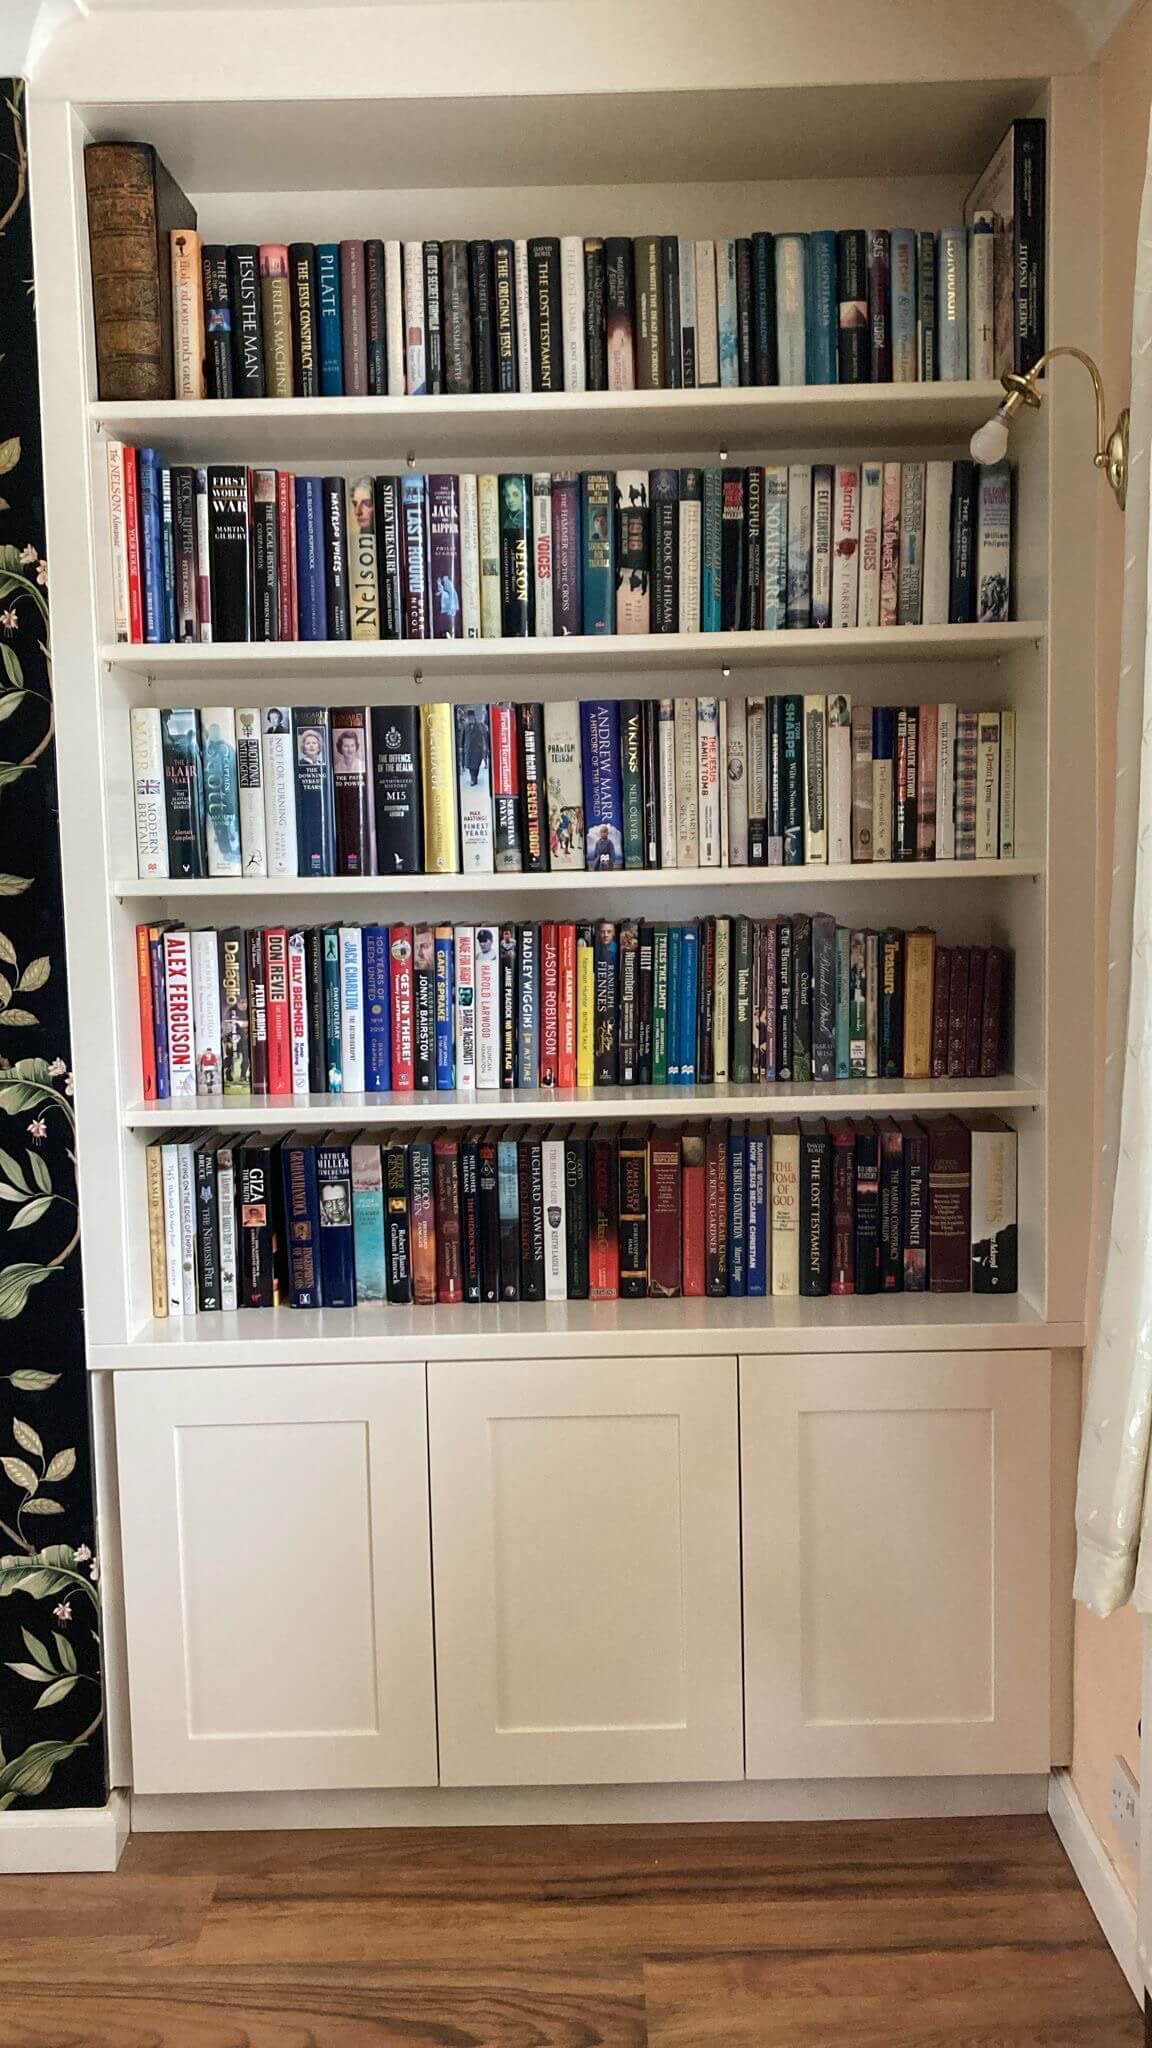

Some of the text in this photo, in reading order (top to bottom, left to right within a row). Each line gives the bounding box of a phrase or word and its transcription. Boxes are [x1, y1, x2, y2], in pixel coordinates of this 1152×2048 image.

[297, 260, 308, 280] THE
[498, 259, 508, 278] THE
[873, 238, 884, 258] SAS
[217, 260, 227, 301] THE ARK
[297, 282, 310, 308] JESUS
[321, 255, 336, 317] PILATE
[820, 243, 830, 326] MESOPOTAMIA
[238, 256, 258, 378] JESUS THE MAN
[498, 281, 510, 329] ORIGINAL
[538, 262, 551, 388] THE LOST TESTAMENT
[272, 280, 287, 395] URIEL'S MACHINE
[300, 310, 312, 369] CONSPIRACY
[499, 332, 512, 357] JESUS
[162, 470, 171, 501] KILLING
[213, 477, 244, 486] FIRST
[749, 473, 760, 537] HOTSPUR
[181, 475, 192, 554] JACK RIPPER
[384, 485, 395, 574] STOLEN TREASURE
[960, 497, 969, 577] THE LODGER
[407, 509, 424, 593] LAST ROUND
[516, 538, 528, 601] NELSON
[538, 536, 550, 578] VOICES
[664, 504, 672, 623] THE BOOK OF HIRAM
[766, 503, 779, 609] NOAH'S ARK
[864, 528, 876, 571] VOICES
[355, 536, 376, 626] Nelson
[524, 731, 535, 752] ANDY
[785, 704, 796, 758] SHARPE
[240, 740, 248, 788] INTELLIGENCE
[248, 740, 259, 787] EMOTIONAL
[592, 756, 598, 766] OF
[598, 706, 613, 821] ANDREW MARR
[387, 792, 406, 800] MI5
[527, 783, 537, 818] SEVEN
[138, 803, 148, 854] BRITAIN
[148, 802, 158, 854] MODERN
[528, 822, 539, 856] TROOP
[629, 807, 638, 841] OLIVER
[223, 942, 239, 1005] Dallaglio
[270, 937, 285, 1000] DON REVIE
[345, 942, 358, 1010] JACK CHARLTON
[522, 931, 533, 1028] BRADLEY WIGGINS
[623, 952, 634, 1000] Nuremberg
[640, 946, 651, 970] REILLY
[884, 942, 899, 994] Treasure
[167, 939, 190, 1064] ALEX FERGUSON
[256, 985, 265, 1007] PETER
[292, 956, 303, 1037] BILLY BREMNER
[481, 965, 491, 1038] HAROLD LARWOOD
[545, 943, 556, 1055] JASON ROBINSON
[598, 961, 607, 1012] FIENNES
[800, 972, 808, 1005] Orchard
[420, 1010, 428, 1060] BAIRSTOW
[505, 1020, 512, 1029] NO
[523, 1048, 531, 1060] MY
[566, 1152, 576, 1186] GOLD
[733, 1152, 742, 1168] THE
[183, 1180, 190, 1190] ON
[250, 1168, 263, 1202] GIZA
[414, 1179, 422, 1216] HEAVEN
[422, 1178, 430, 1209] FLOOD
[531, 1147, 542, 1260] RICHARD DAWKINS
[734, 1194, 743, 1238] CONNECTION
[810, 1158, 820, 1273] THE LOST TESTAMENT
[203, 1228, 212, 1266] NEMESIS
[205, 1267, 214, 1287] FILE
